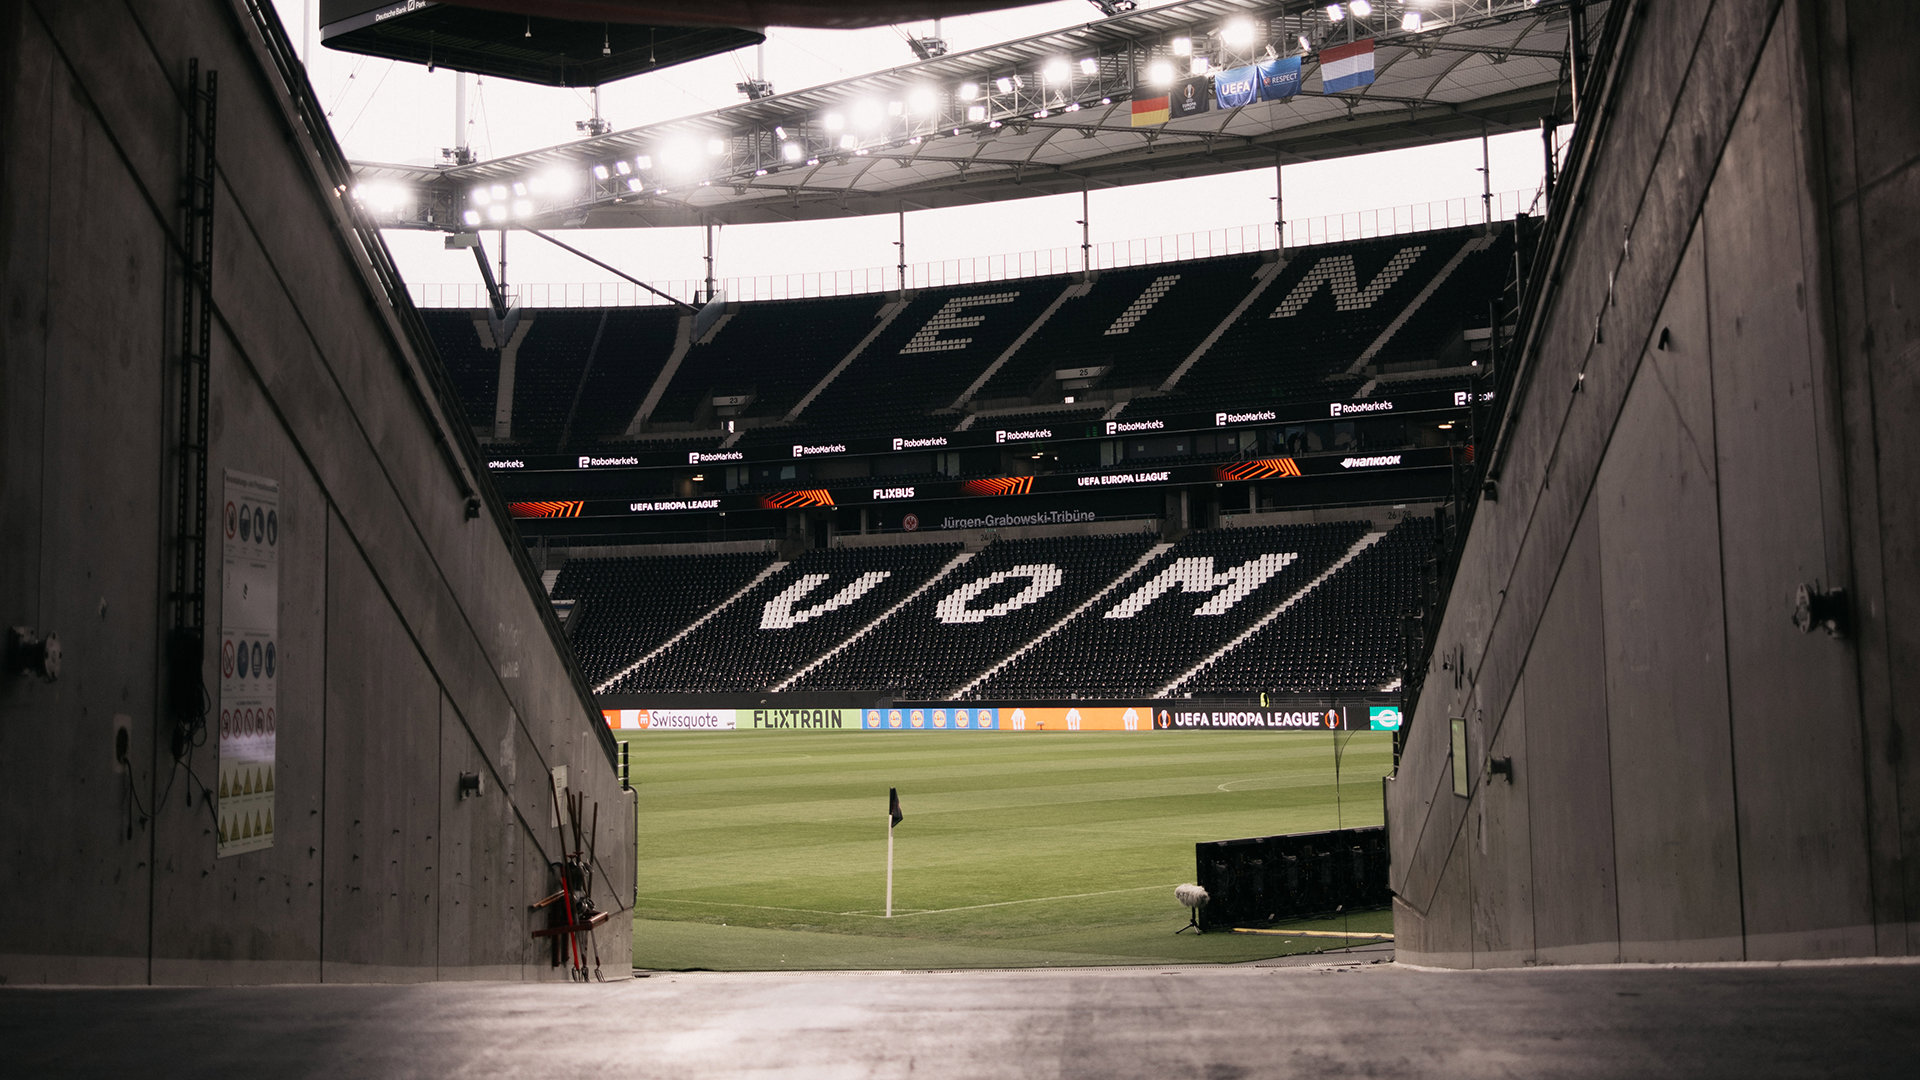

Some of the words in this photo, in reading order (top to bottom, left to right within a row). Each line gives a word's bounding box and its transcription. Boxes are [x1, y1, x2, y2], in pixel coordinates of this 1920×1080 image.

[375, 10, 395, 21] Deutsche
[396, 6, 407, 15] Bank
[1271, 72, 1298, 84] RESPECT
[1221, 80, 1250, 95] UEFA
[1079, 368, 1089, 376] 25
[1342, 400, 1394, 414] RoboMarkets
[1227, 410, 1277, 423] RoboMarkets
[1117, 419, 1165, 432] RoboMarkets
[1006, 428, 1053, 441] RoboMarkets
[903, 436, 948, 448] RoboMarkets
[803, 443, 847, 455] RoboMarkets
[590, 456, 639, 467] RoboMarkets
[700, 450, 744, 462] RoboMarkets
[1077, 476, 1101, 487] UEFA
[1100, 474, 1135, 485] EUROPA
[630, 503, 654, 511] UEFA
[654, 502, 688, 511] EUROPA
[940, 509, 1095, 530] Jürgen-Grabowski-Tribüne
[652, 710, 718, 729] Swissquote
[1174, 712, 1210, 726] UEFA
[1212, 712, 1265, 726] EUROPA
